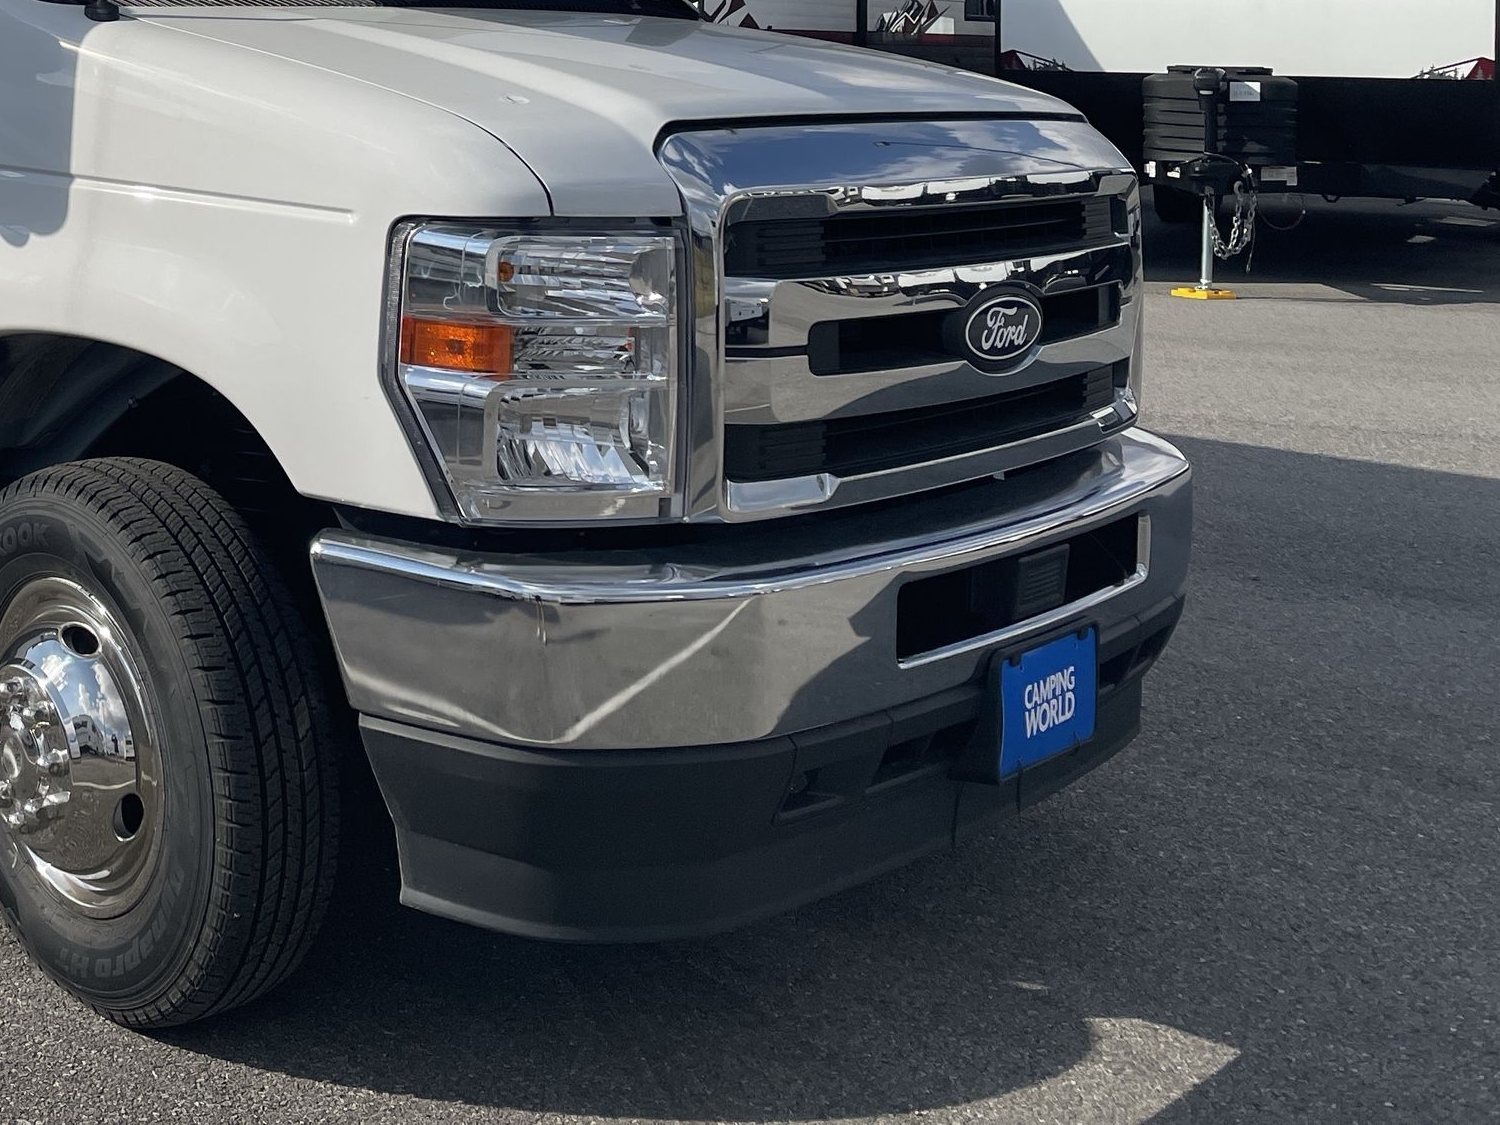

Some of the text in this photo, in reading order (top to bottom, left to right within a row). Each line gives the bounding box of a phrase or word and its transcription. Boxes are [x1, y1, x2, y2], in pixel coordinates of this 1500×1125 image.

[981, 306, 1029, 350] Ford
[1024, 665, 1076, 709] CAMPING
[1024, 691, 1076, 739] WORLD
